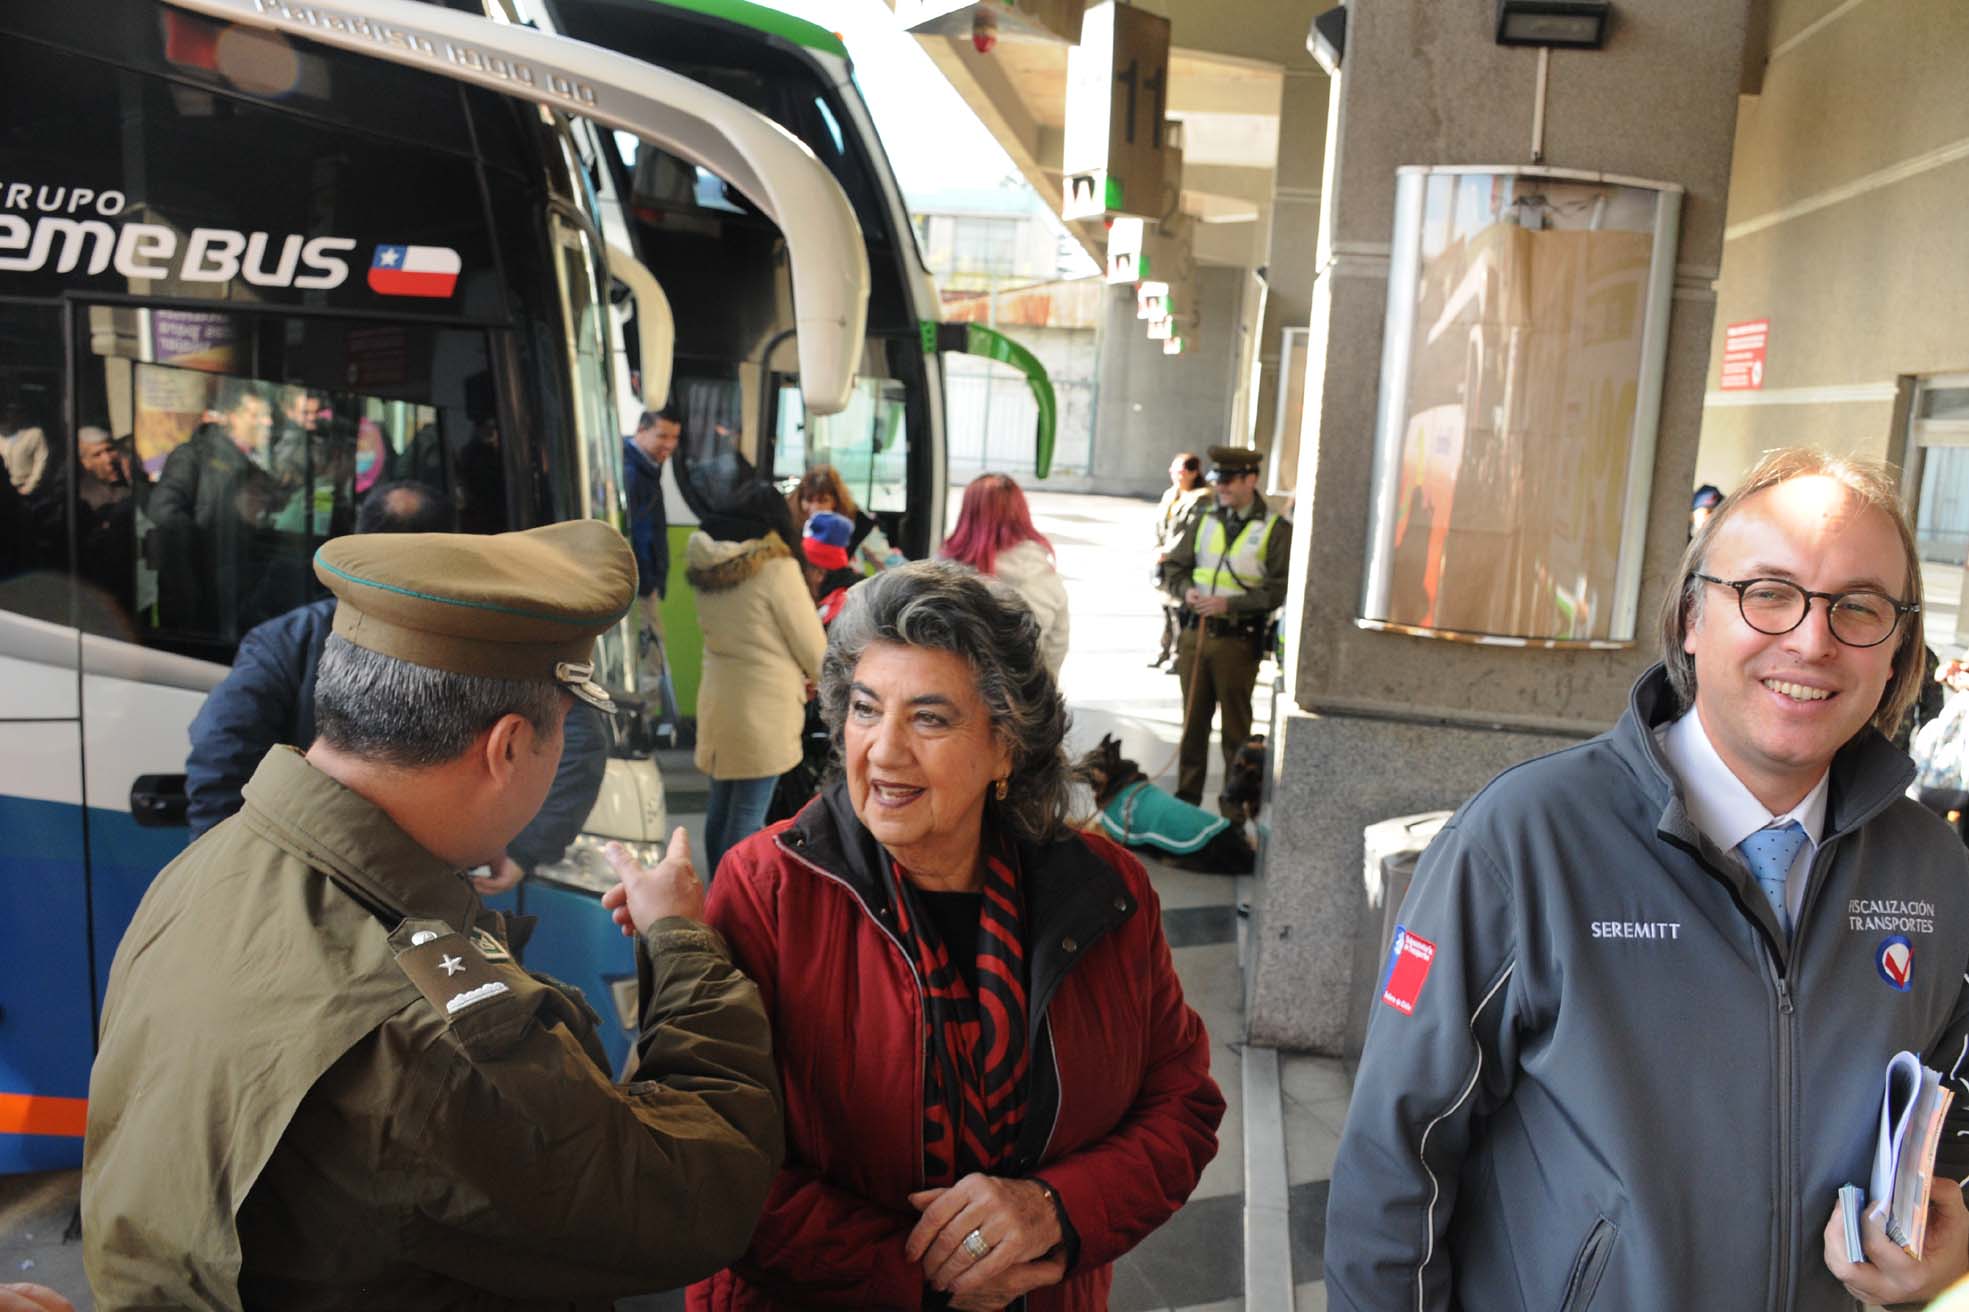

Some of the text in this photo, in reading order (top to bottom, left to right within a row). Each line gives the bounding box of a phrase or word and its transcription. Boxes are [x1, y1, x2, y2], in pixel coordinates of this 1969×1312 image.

[1116, 59, 1164, 148] 11
[0, 183, 125, 216] RUPO
[1591, 921, 1681, 939] SEREMITT
[1849, 916, 1934, 933] TRANSPORTES
